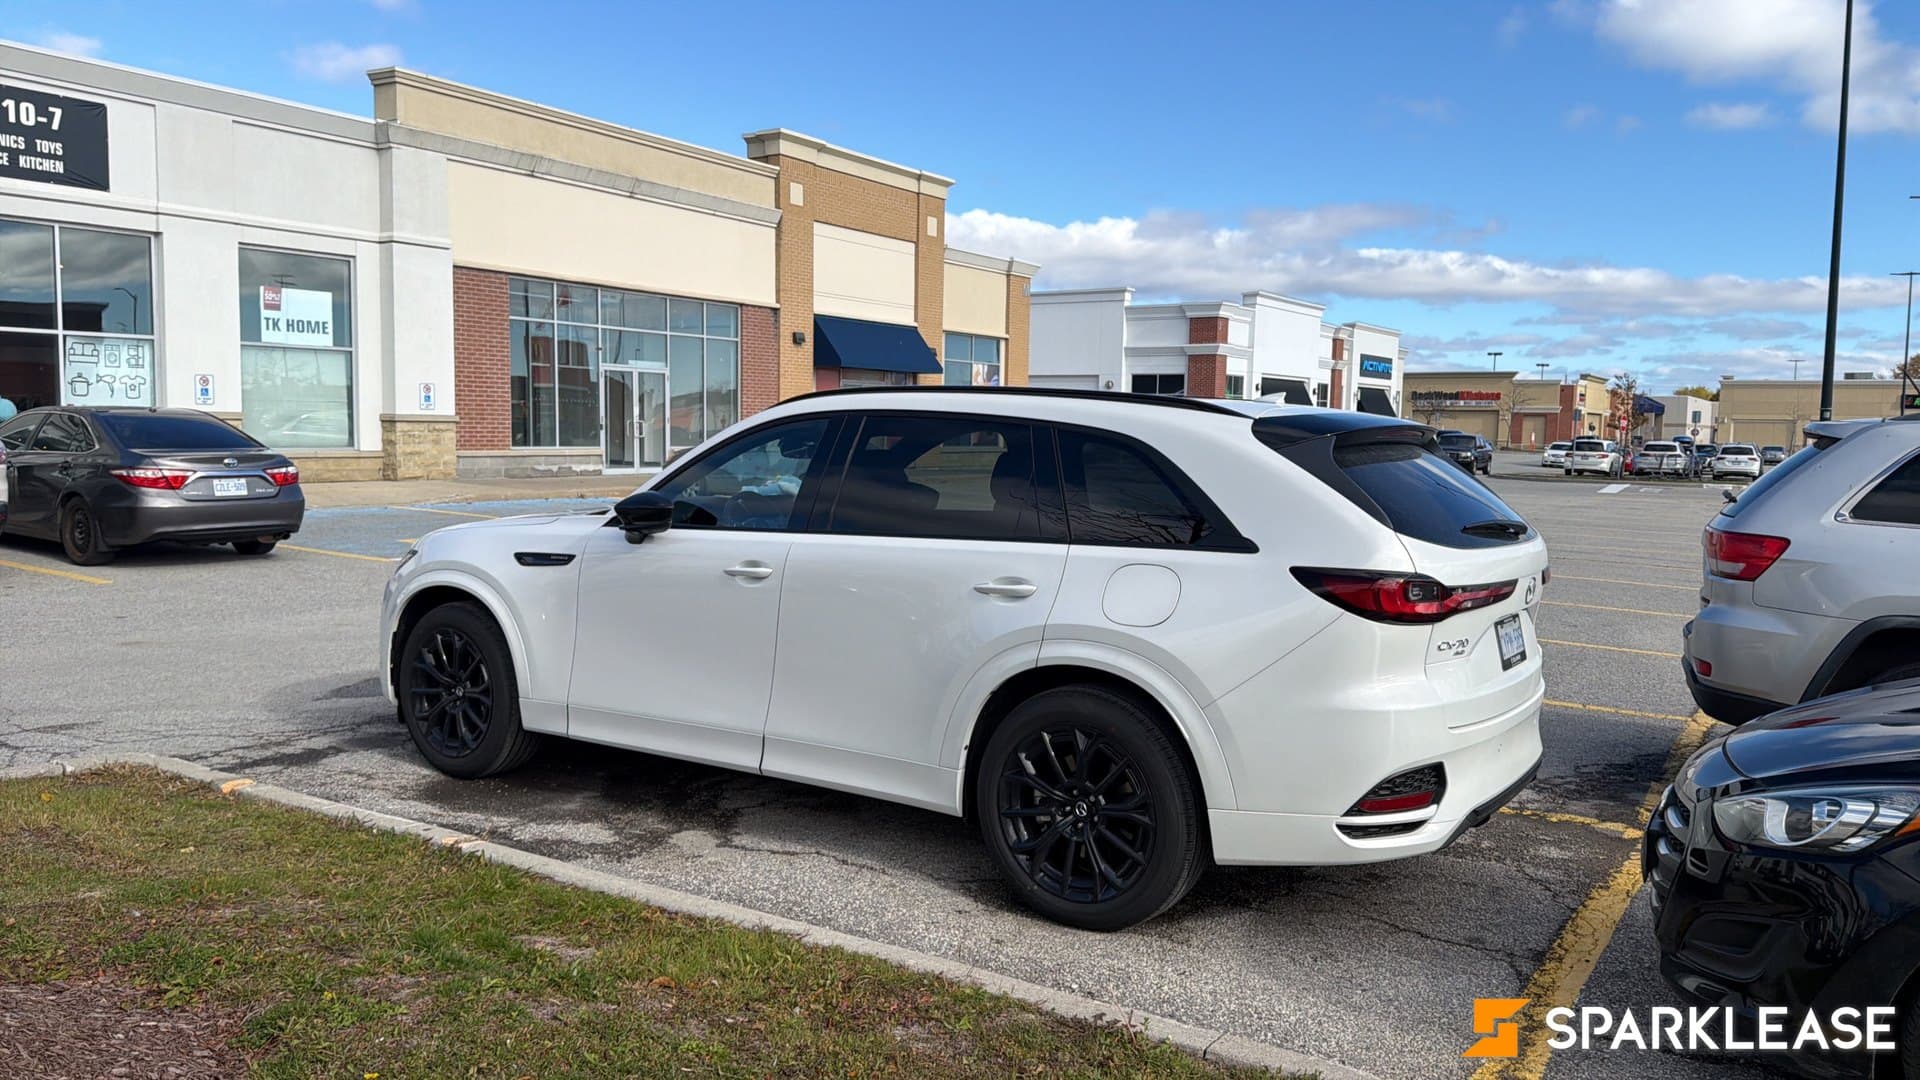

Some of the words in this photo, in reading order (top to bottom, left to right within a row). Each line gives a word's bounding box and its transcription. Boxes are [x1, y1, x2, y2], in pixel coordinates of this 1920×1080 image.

[1, 99, 63, 131] 10-7
[35, 139, 63, 156] TOYS
[19, 154, 64, 174] KITCHEN
[263, 316, 282, 332] TK
[286, 318, 330, 335] HOME
[1437, 638, 1470, 652] CX-70
